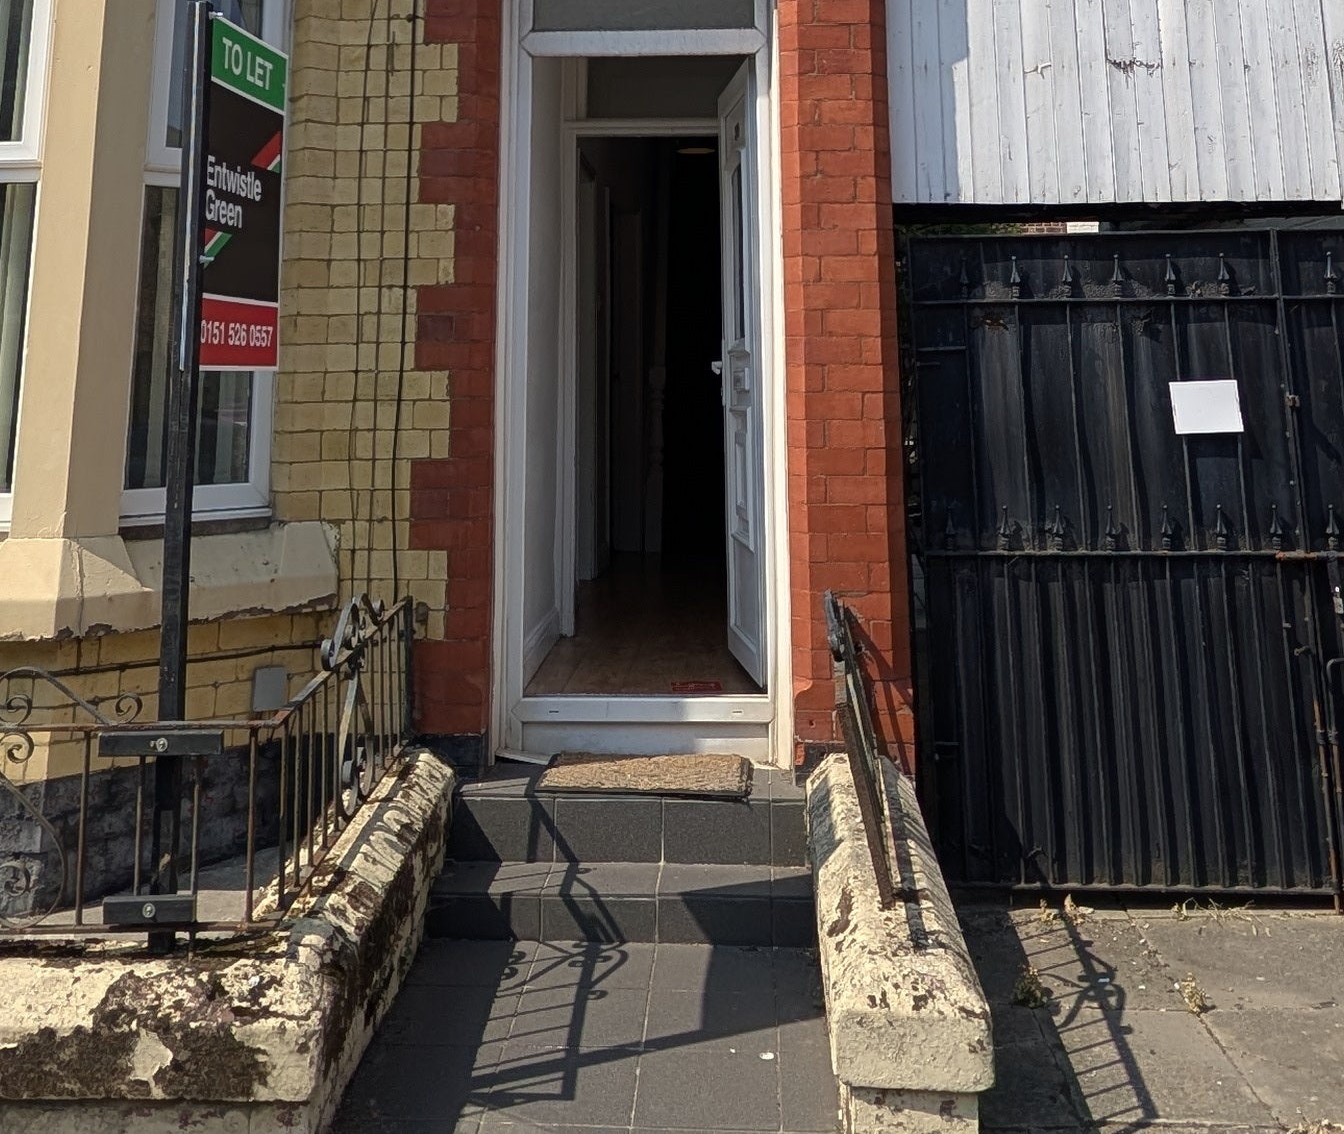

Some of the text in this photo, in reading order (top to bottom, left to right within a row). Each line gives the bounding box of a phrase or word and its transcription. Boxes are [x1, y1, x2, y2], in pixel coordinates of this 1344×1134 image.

[222, 36, 273, 91] TO LET
[207, 154, 262, 202] Entwistle
[205, 188, 243, 229] Green
[200, 319, 274, 348] 0151 526 0557
